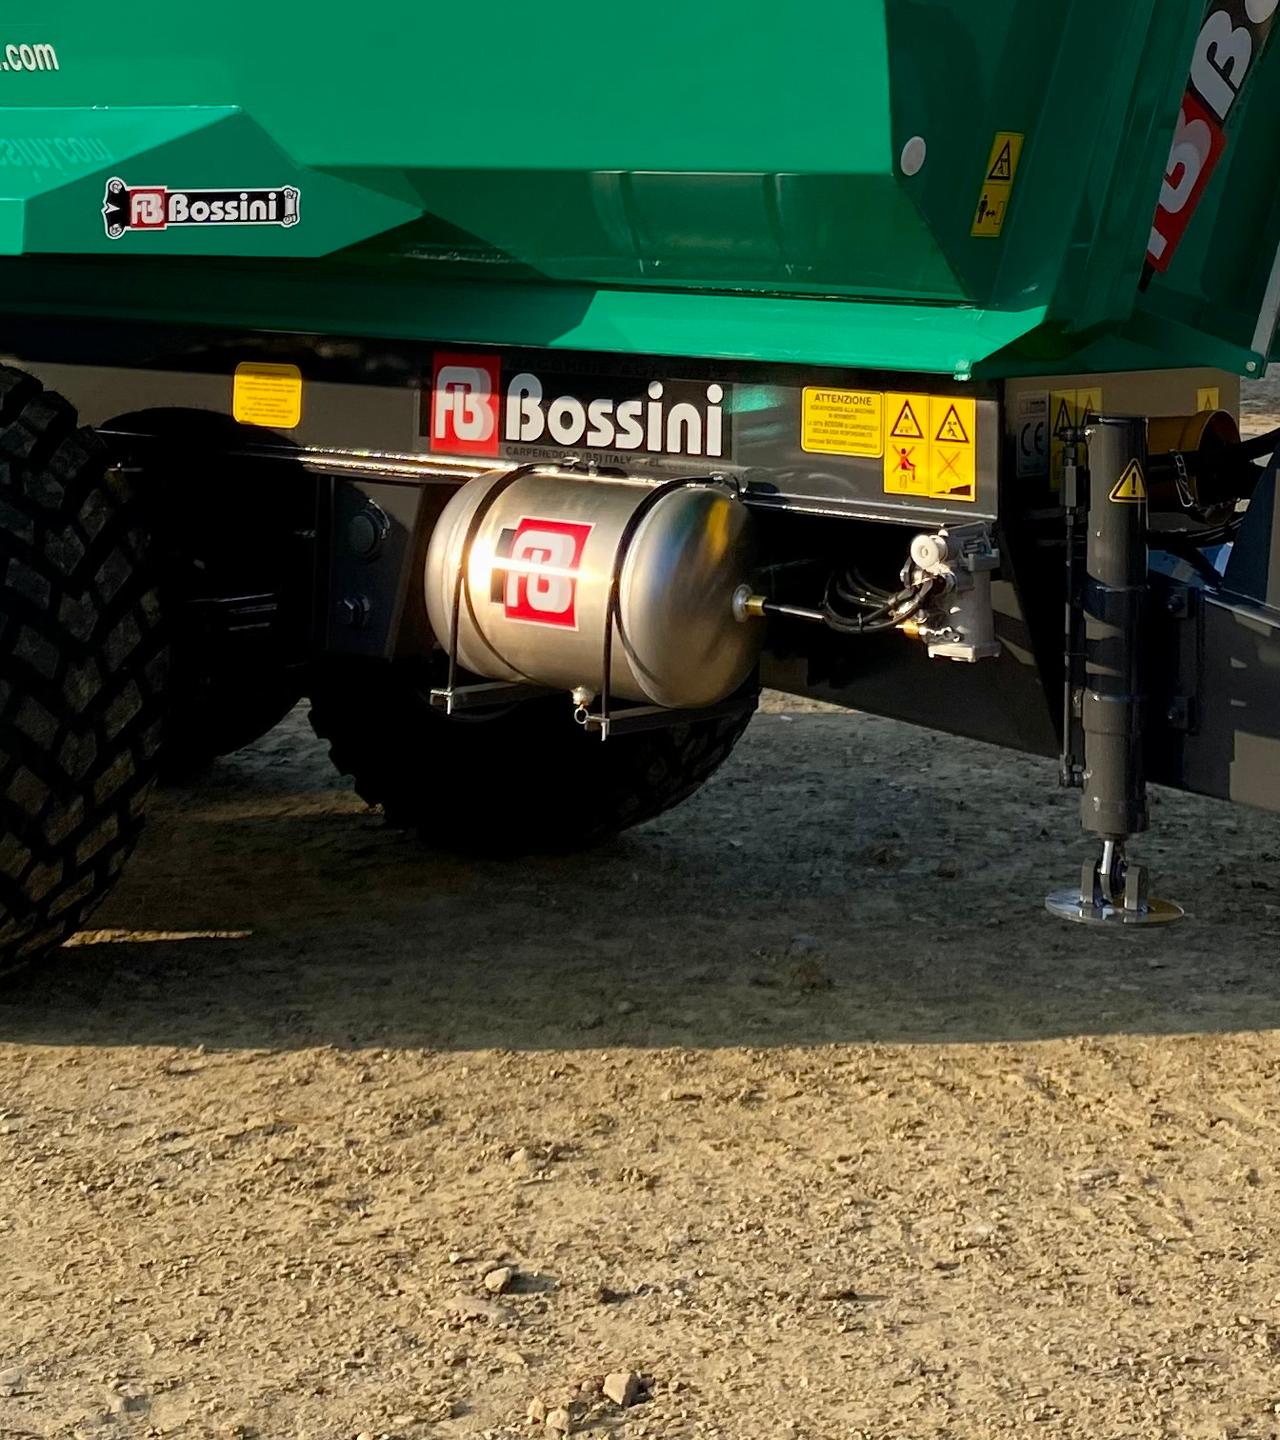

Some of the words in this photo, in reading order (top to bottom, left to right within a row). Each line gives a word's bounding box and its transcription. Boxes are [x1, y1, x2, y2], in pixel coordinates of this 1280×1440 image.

[168, 192, 277, 222] Bossini
[814, 392, 873, 407] ATTENZIONE
[505, 373, 724, 457] Bossini
